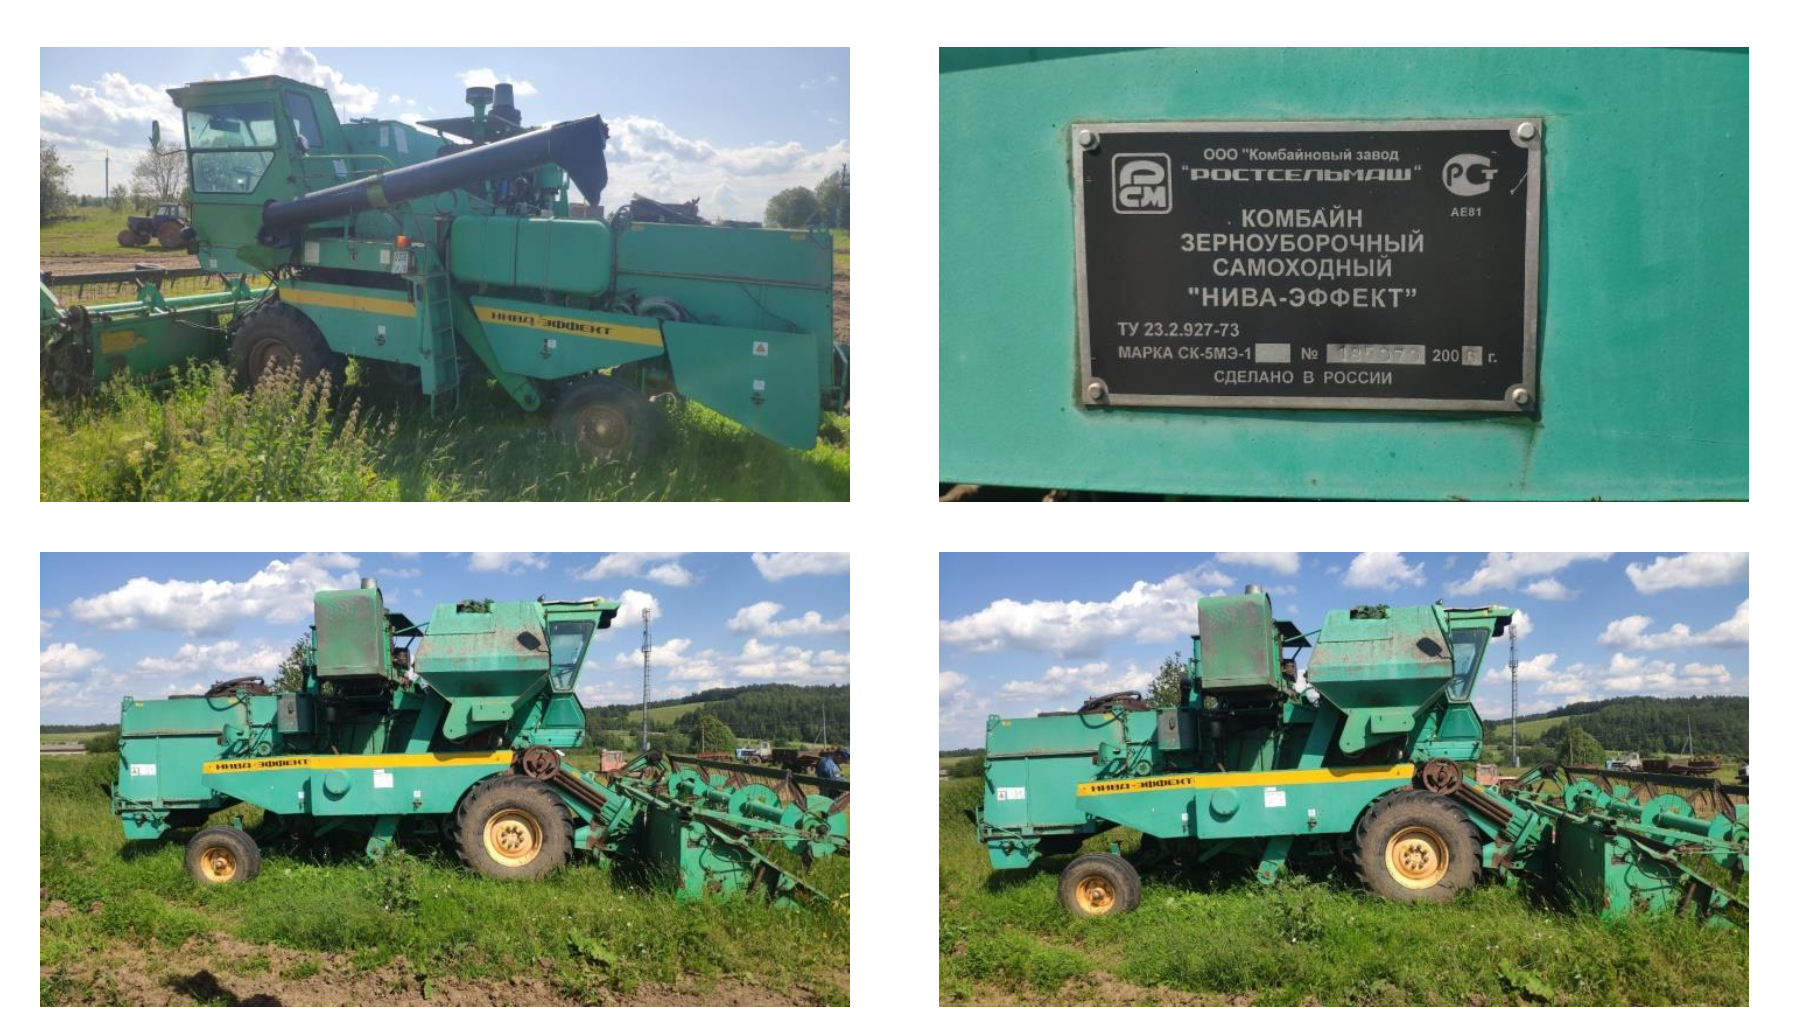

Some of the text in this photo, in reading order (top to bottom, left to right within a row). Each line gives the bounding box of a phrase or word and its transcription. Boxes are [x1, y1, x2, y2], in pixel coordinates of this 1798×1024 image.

[1203, 148, 1399, 162] ООО "Комбайновый завод
[1242, 204, 1363, 228] КОМБАЙН
[1181, 229, 1424, 252] ЗЕРНОУБОРОЧНЫЙ
[1213, 255, 1393, 280] САМОХОДНЫЙ
[1117, 322, 1240, 338] ТУ 23.2.927-73
[1118, 346, 1173, 360] МАРКА
[1178, 346, 1251, 360] СК-5МЭ-1
[1301, 348, 1319, 360] №
[1487, 352, 1498, 363] г.
[1214, 370, 1393, 386] СДЕЛАНО В РОССИИ
